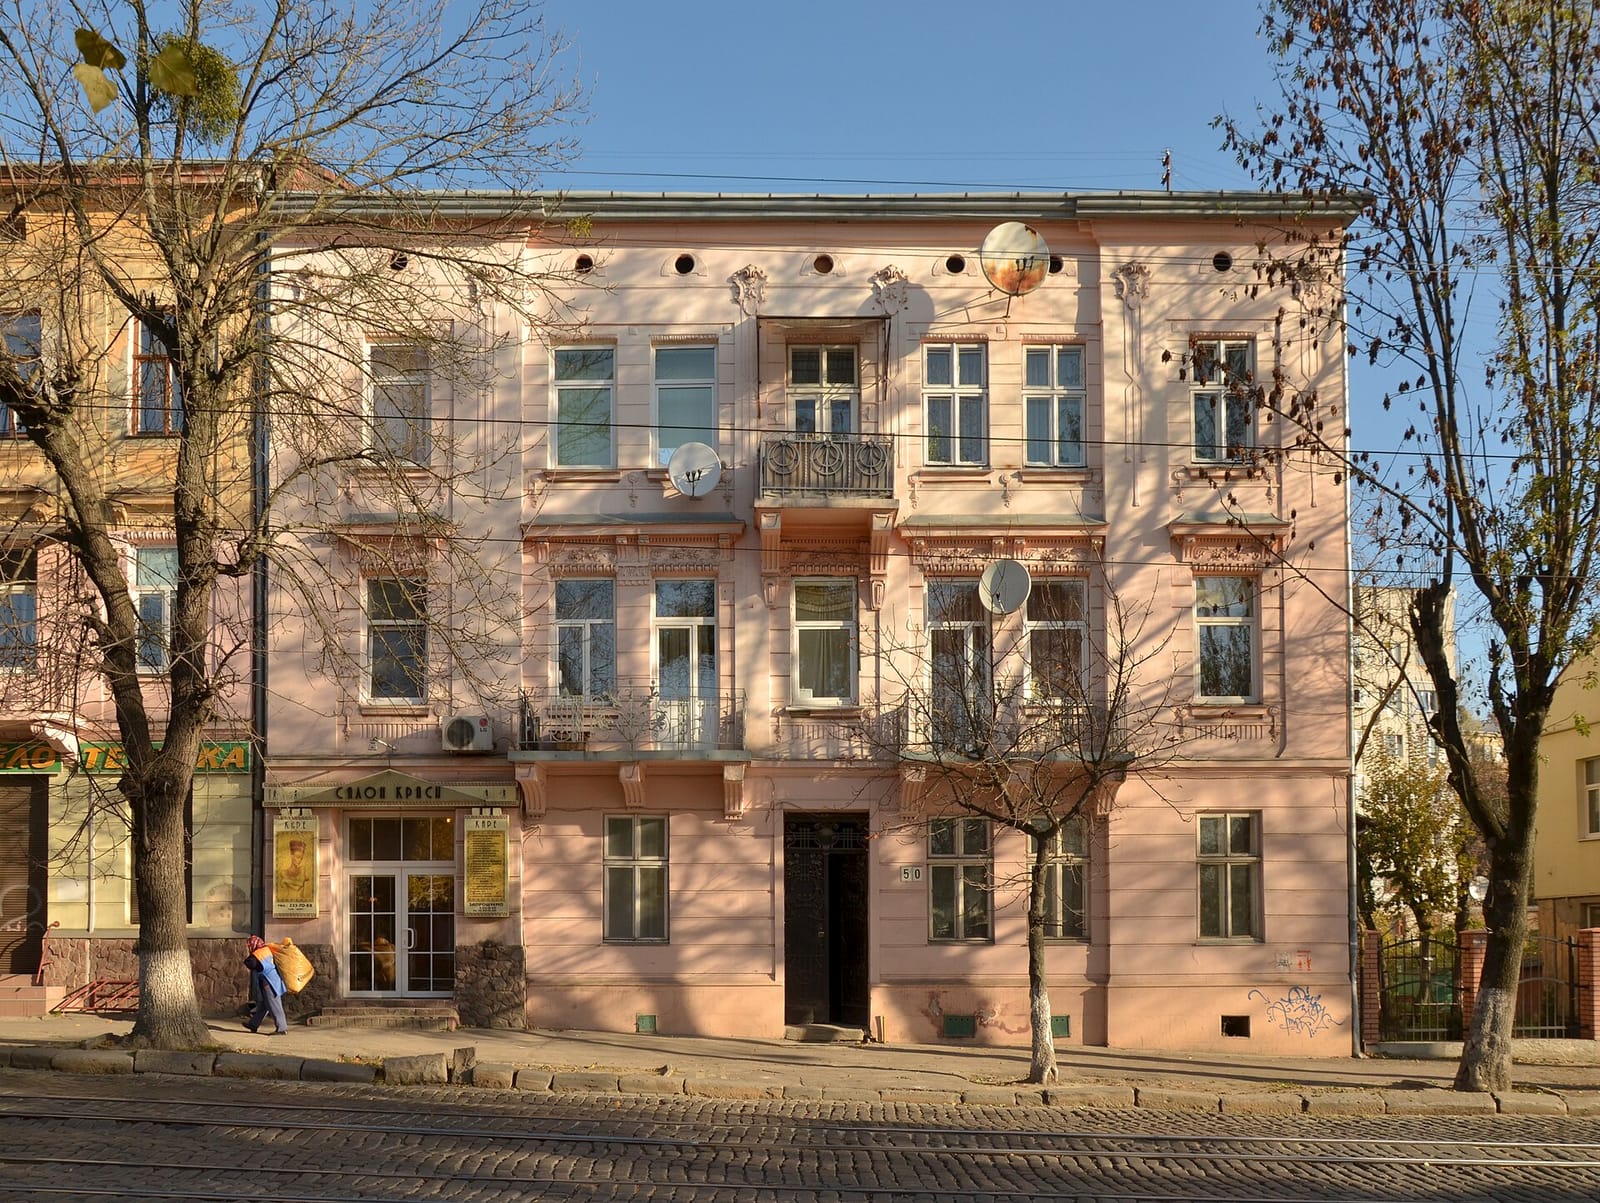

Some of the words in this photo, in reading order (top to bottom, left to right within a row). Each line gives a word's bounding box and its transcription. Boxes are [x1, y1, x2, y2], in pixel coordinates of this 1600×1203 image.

[335, 786, 386, 799] САЛОН
[395, 786, 441, 799] КРАСИ
[903, 868, 921, 880] 50
